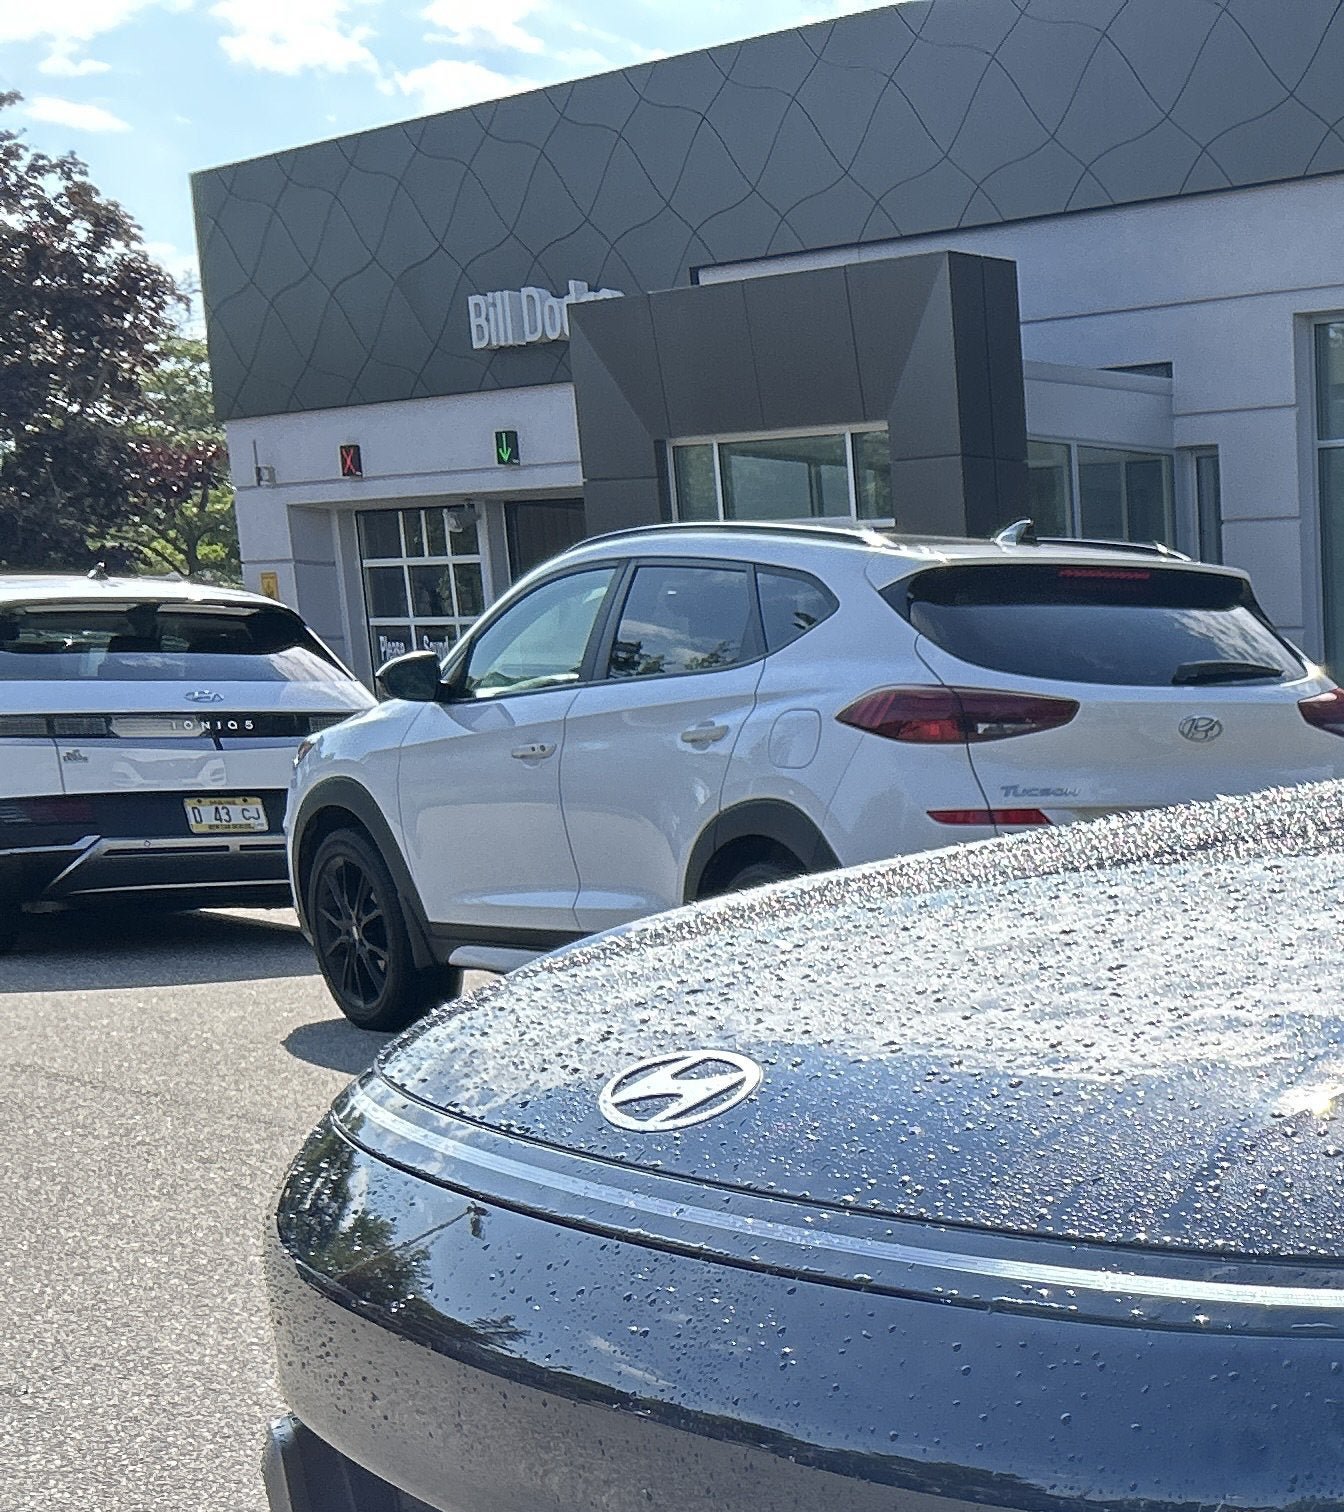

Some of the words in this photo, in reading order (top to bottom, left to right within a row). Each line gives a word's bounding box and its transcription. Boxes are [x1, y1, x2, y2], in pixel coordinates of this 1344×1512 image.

[468, 290, 513, 349] Bill
[171, 719, 238, 730] IONIQ
[244, 719, 254, 730] 5
[214, 806, 232, 823] 43
[241, 807, 261, 821] CJ
